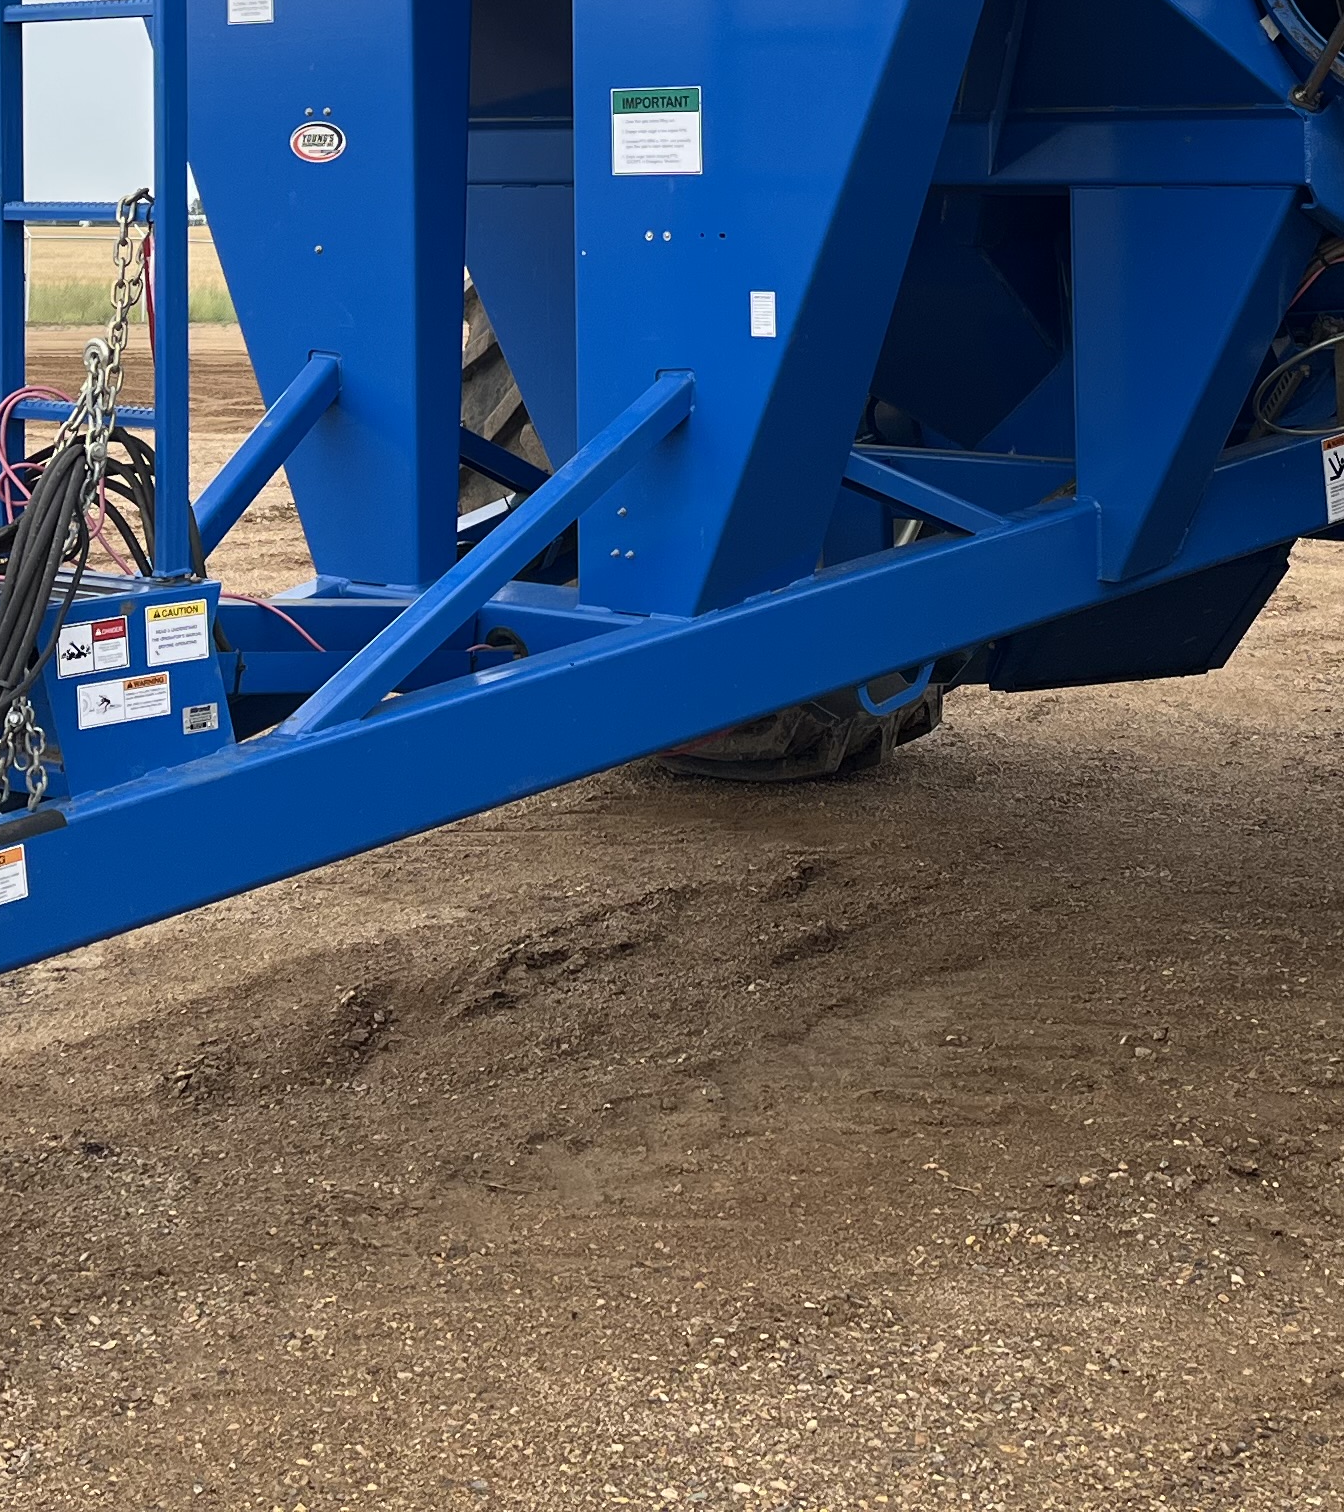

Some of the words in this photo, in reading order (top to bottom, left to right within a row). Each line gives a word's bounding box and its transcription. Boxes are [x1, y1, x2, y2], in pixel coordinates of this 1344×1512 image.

[622, 95, 690, 110] IMPORTANT
[302, 133, 334, 144] YOUNG'S
[162, 605, 199, 618] CAUTION
[133, 676, 164, 688] WARNING
